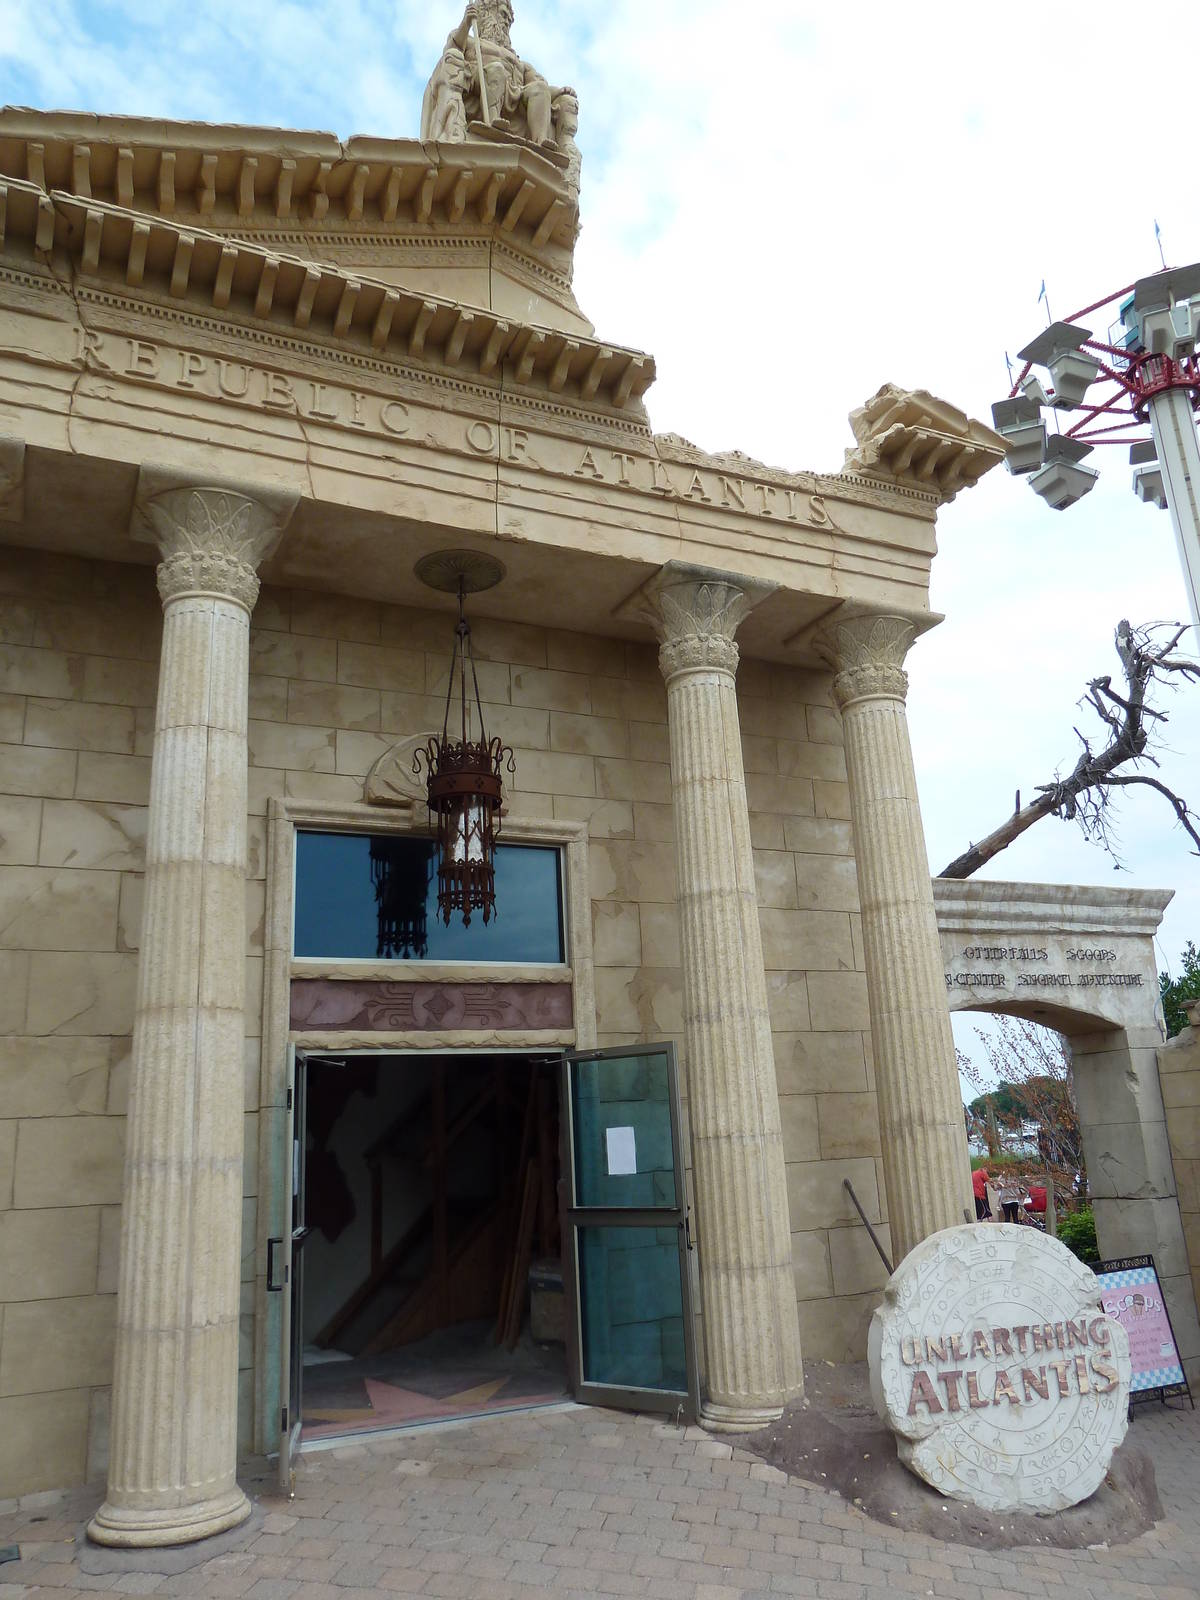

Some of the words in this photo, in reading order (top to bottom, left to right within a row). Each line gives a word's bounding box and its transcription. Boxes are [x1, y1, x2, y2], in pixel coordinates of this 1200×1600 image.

[71, 326, 411, 434] REPUBLIC
[465, 420, 531, 461] OF
[573, 445, 830, 524] ATLANTIS
[963, 946, 1008, 960] OTTER
[1008, 946, 1048, 960] FALLS
[1066, 948, 1117, 961] SCOOPS
[1018, 973, 1076, 986] SNORKEL
[1077, 973, 1145, 986] ADVENTURE
[901, 1317, 1111, 1366] UNEARTHING
[906, 1350, 1120, 1416] ATLANTIS
